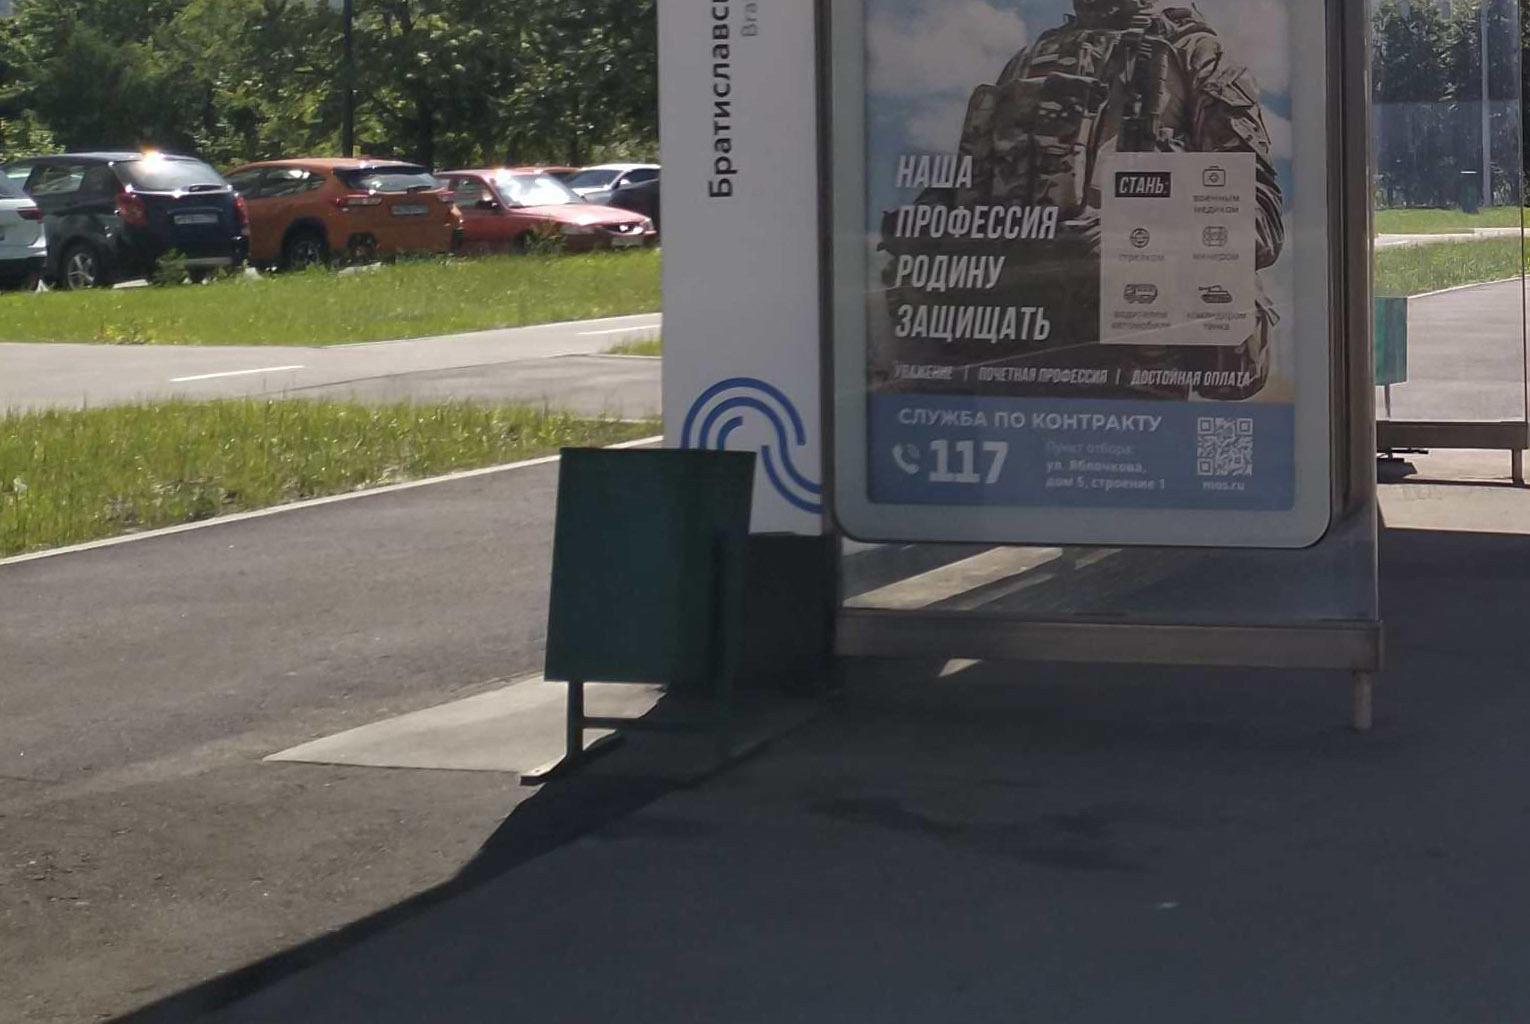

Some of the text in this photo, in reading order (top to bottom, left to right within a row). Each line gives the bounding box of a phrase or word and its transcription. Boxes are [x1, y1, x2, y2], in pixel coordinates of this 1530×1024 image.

[895, 155, 974, 189] НАША
[895, 205, 1060, 240] ПРОФЕССИЯ
[894, 254, 1006, 293] РОДИНУ
[895, 304, 1051, 344] ЗАЩИЩАТЬ
[977, 366, 1036, 382] ПОЧЕТНАЯ
[1037, 367, 1109, 385] ПРОФЕССИЯ
[1130, 368, 1202, 386] ДОСТОЙНАЯ
[1203, 370, 1250, 387] ОПЛАТА
[899, 408, 1162, 432] СЛУЖБА ПО КОНТРАКТУ
[928, 439, 1009, 484] 117
